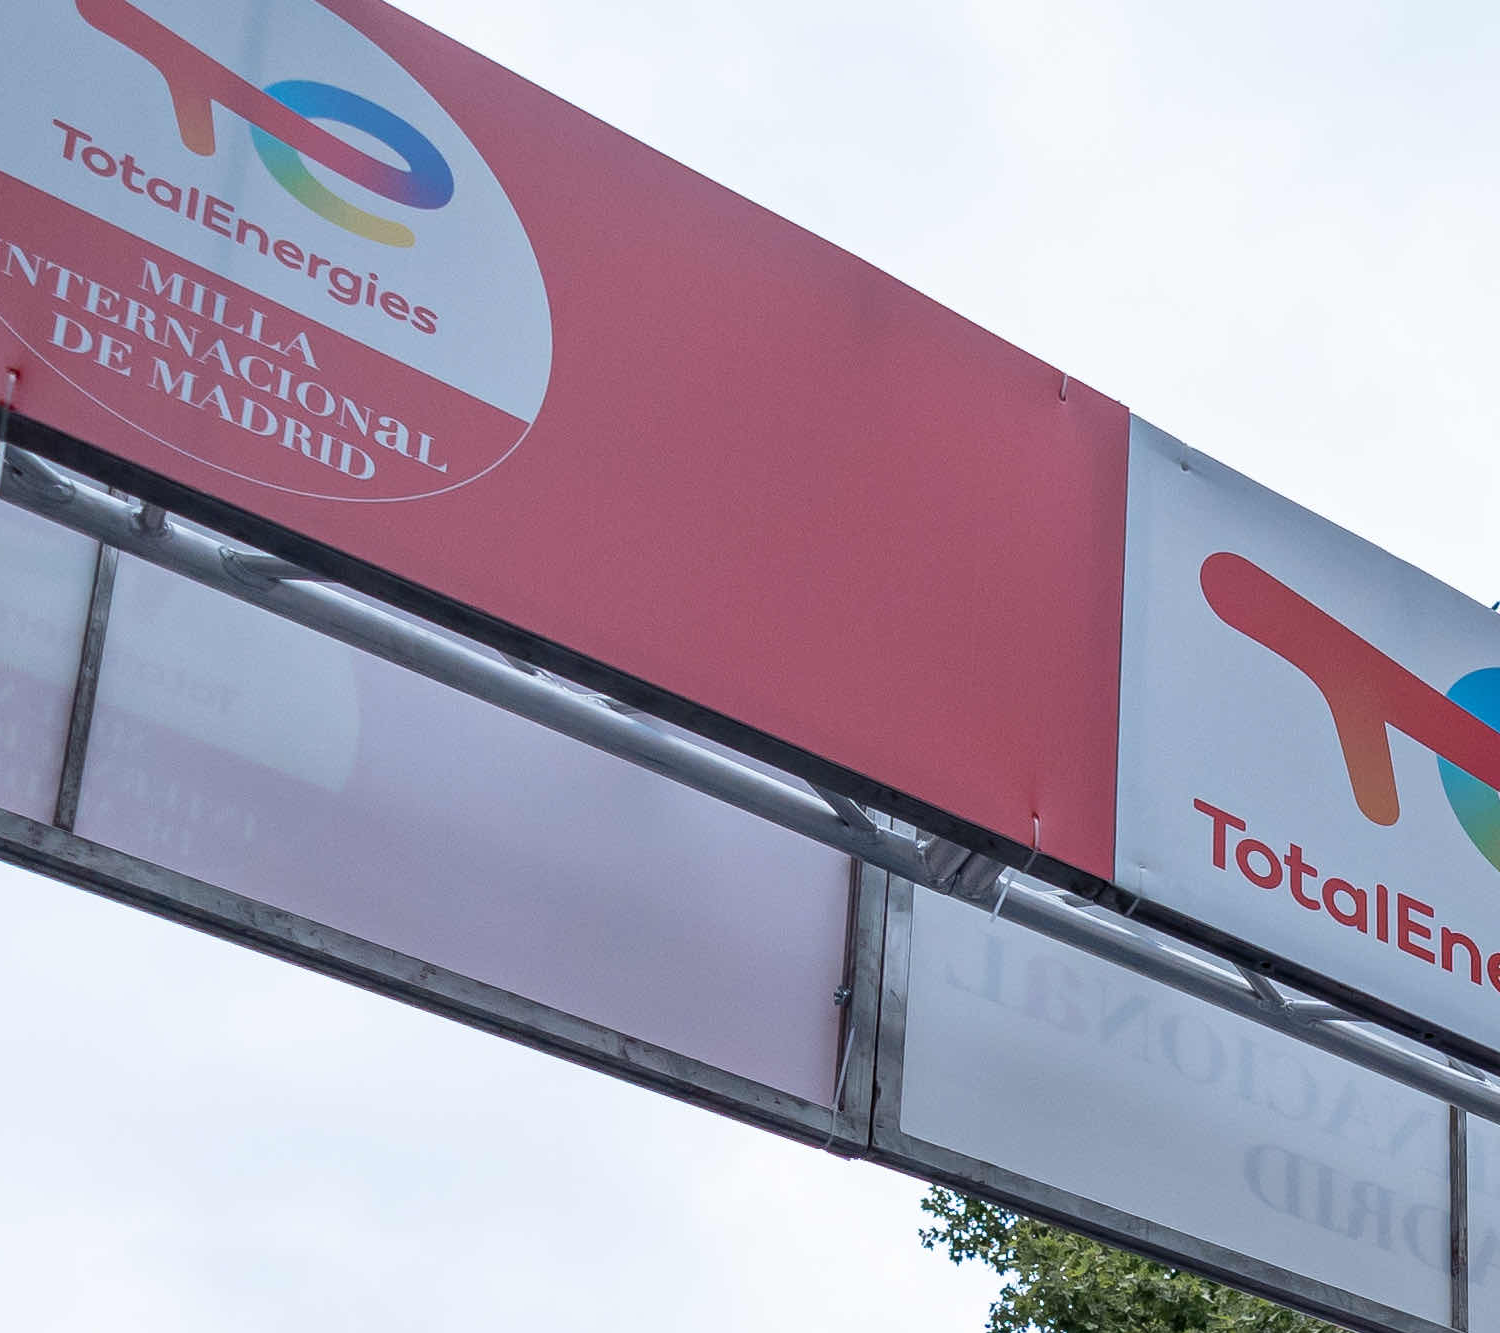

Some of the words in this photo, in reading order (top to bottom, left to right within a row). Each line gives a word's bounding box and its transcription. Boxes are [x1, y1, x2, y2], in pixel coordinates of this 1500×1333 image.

[51, 117, 440, 335] TotalEnergies
[50, 310, 132, 379] DE
[148, 356, 378, 482] MADRID
[137, 256, 323, 371] MILLA
